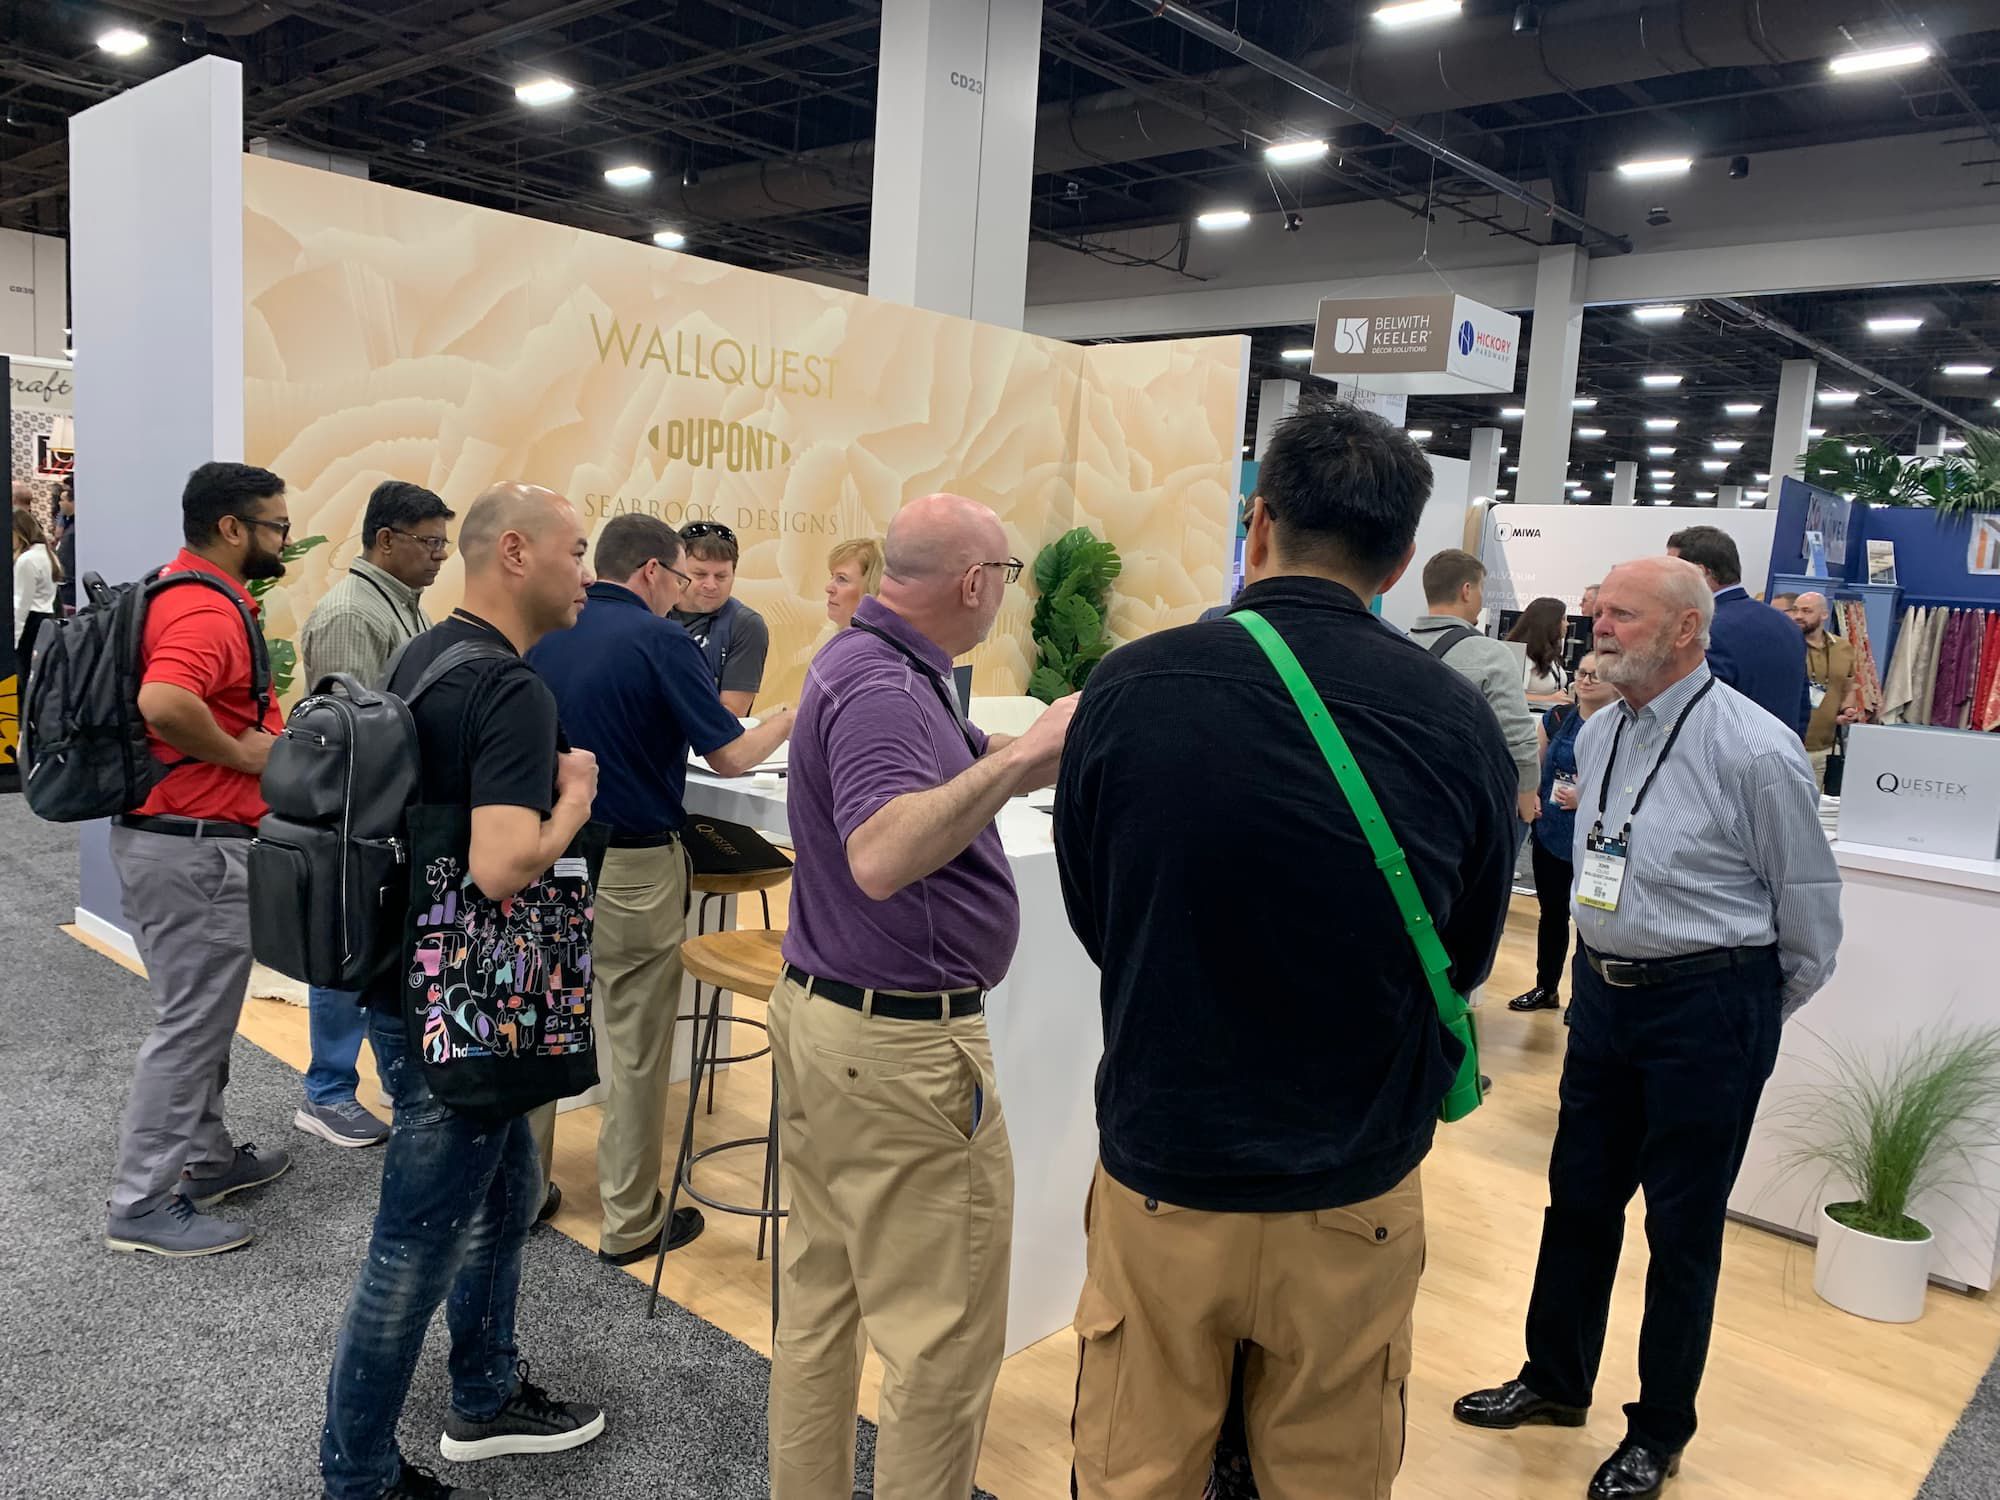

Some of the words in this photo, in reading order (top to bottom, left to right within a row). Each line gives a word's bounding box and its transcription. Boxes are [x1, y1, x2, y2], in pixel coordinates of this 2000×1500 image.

[950, 71, 983, 95] CD23
[1375, 314, 1430, 330] BELWITH
[1393, 345, 1428, 353] SOLUTIONS
[1476, 331, 1511, 355] HICKORY
[589, 313, 841, 400] WALLQUEST
[666, 418, 777, 473] DUPONT
[584, 493, 720, 525] SEABROOK
[737, 507, 838, 536] DESIGNS
[1512, 528, 1541, 538] MIWA
[1876, 772, 1968, 796] QUESTEX
[452, 1043, 468, 1058] hd
